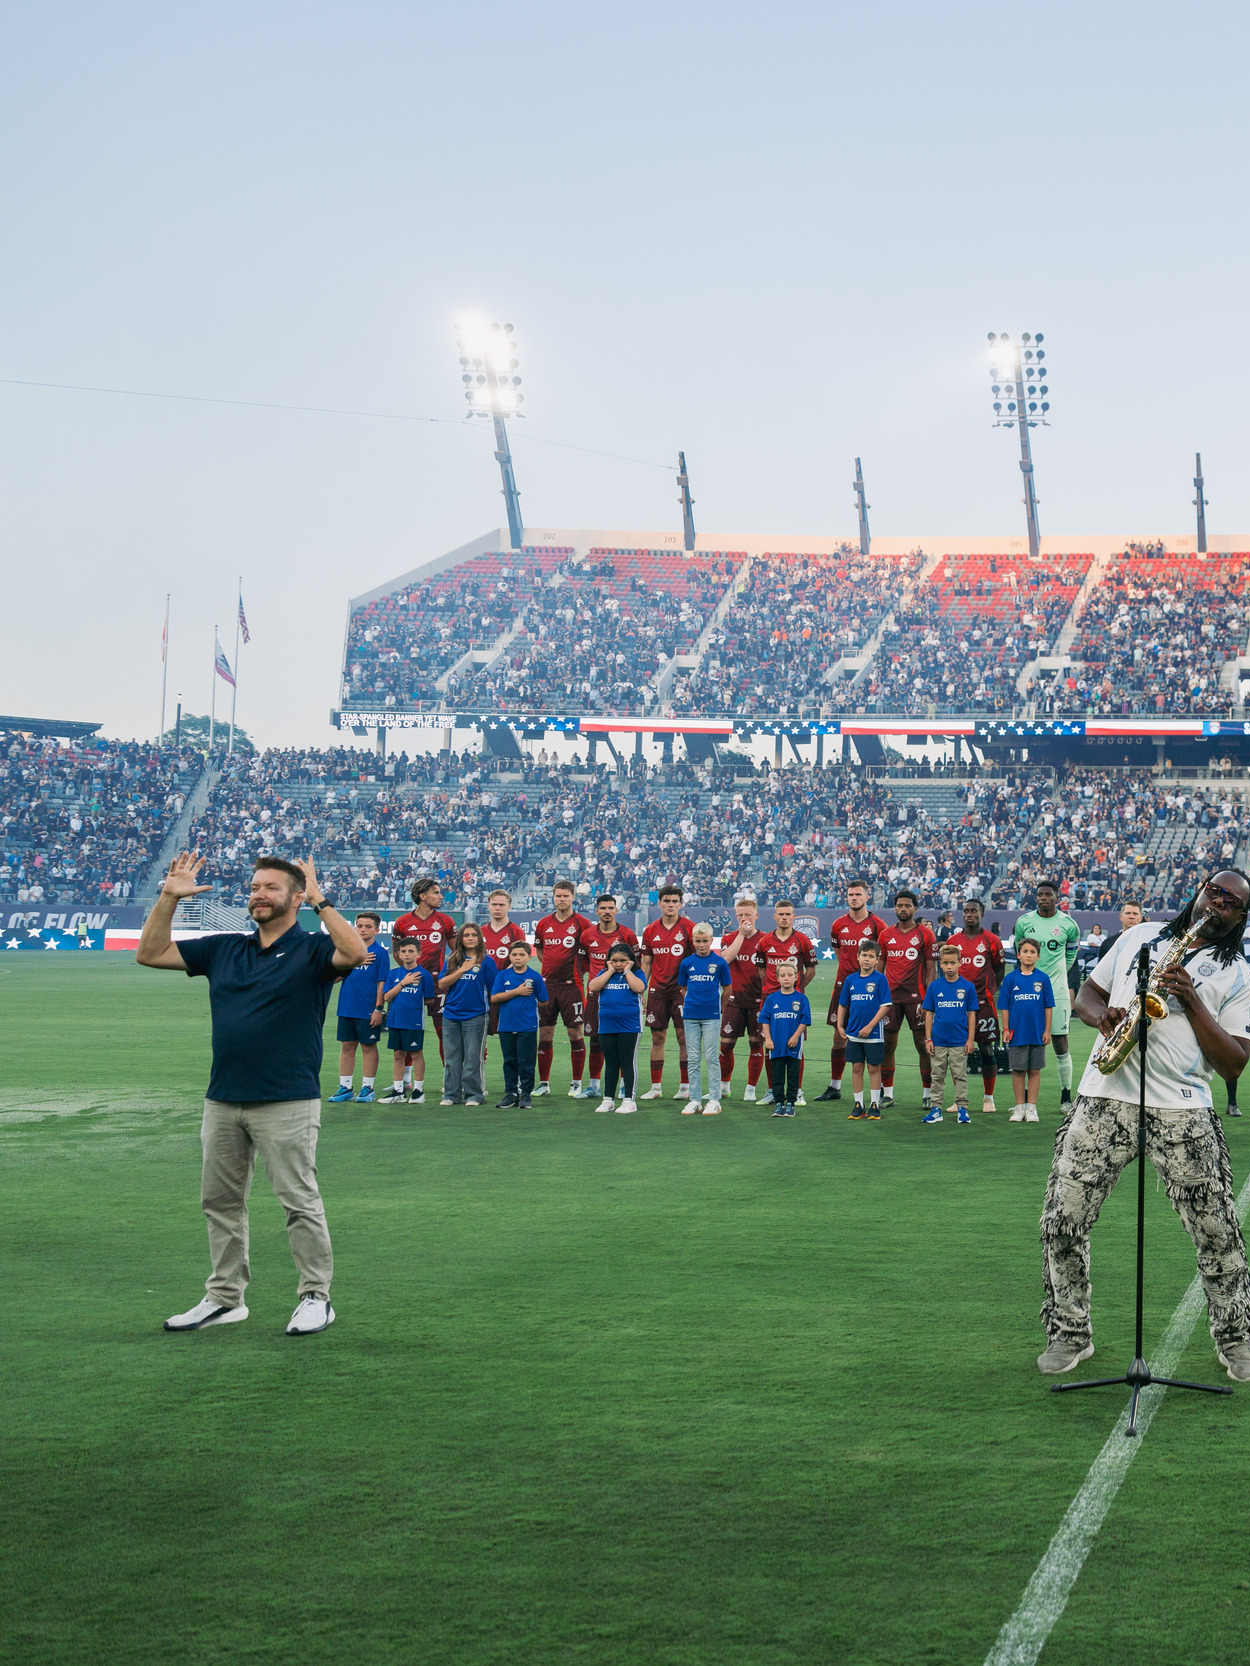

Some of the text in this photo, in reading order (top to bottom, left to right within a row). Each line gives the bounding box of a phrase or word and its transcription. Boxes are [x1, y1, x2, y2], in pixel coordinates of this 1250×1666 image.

[1010, 540, 1022, 548] 205
[340, 713, 395, 721] STAR-SPANGLED
[362, 719, 377, 727] THE
[403, 720, 414, 728] OF
[417, 720, 433, 728] THE
[1013, 993, 1041, 1001] DIRECTV
[572, 1001, 583, 1015] 17
[773, 1012, 798, 1020] DIRECTV
[978, 1017, 996, 1032] 22
